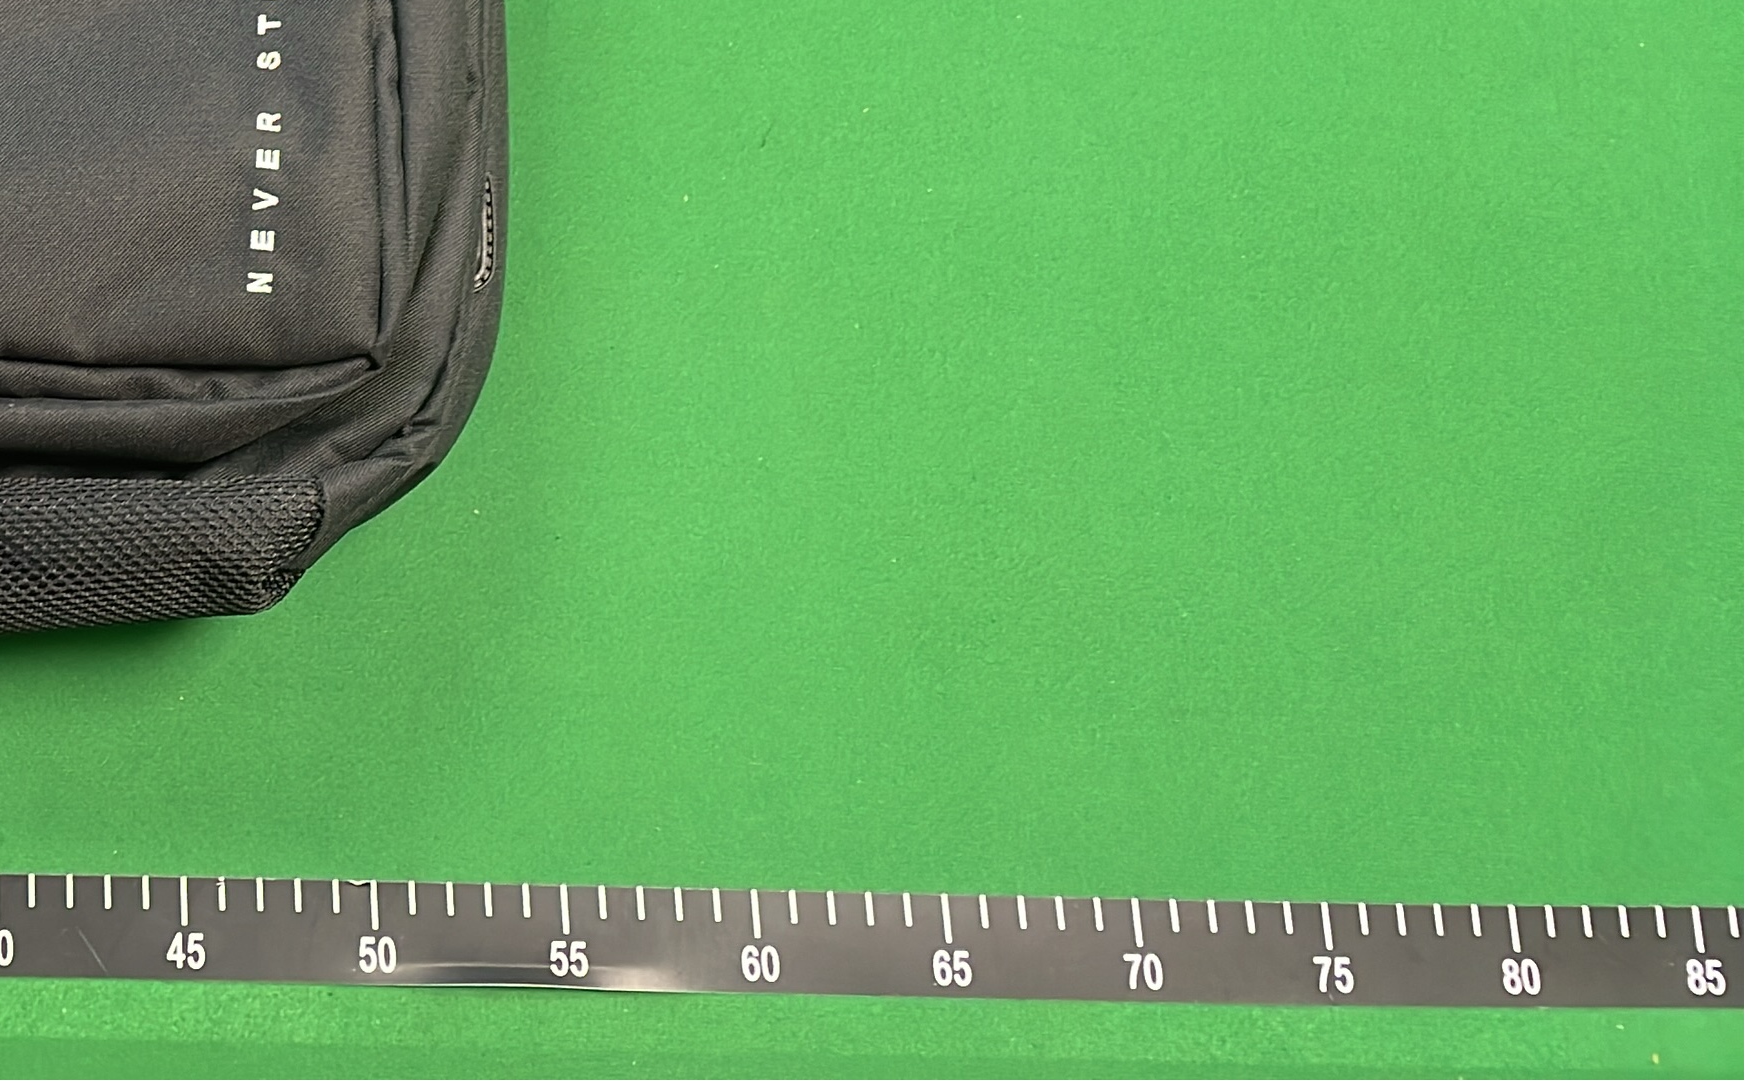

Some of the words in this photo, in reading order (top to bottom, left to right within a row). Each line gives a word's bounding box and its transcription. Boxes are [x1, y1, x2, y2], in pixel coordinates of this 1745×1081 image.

[245, 111, 282, 294] NEVER
[166, 931, 206, 970] 45
[358, 935, 398, 975] 50
[549, 940, 590, 978] 55
[740, 944, 781, 983] 60
[932, 949, 973, 988] 65
[1122, 952, 1164, 991] 70
[1312, 955, 1355, 994] 75
[1501, 957, 1542, 996] 80
[1685, 958, 1727, 996] 85
